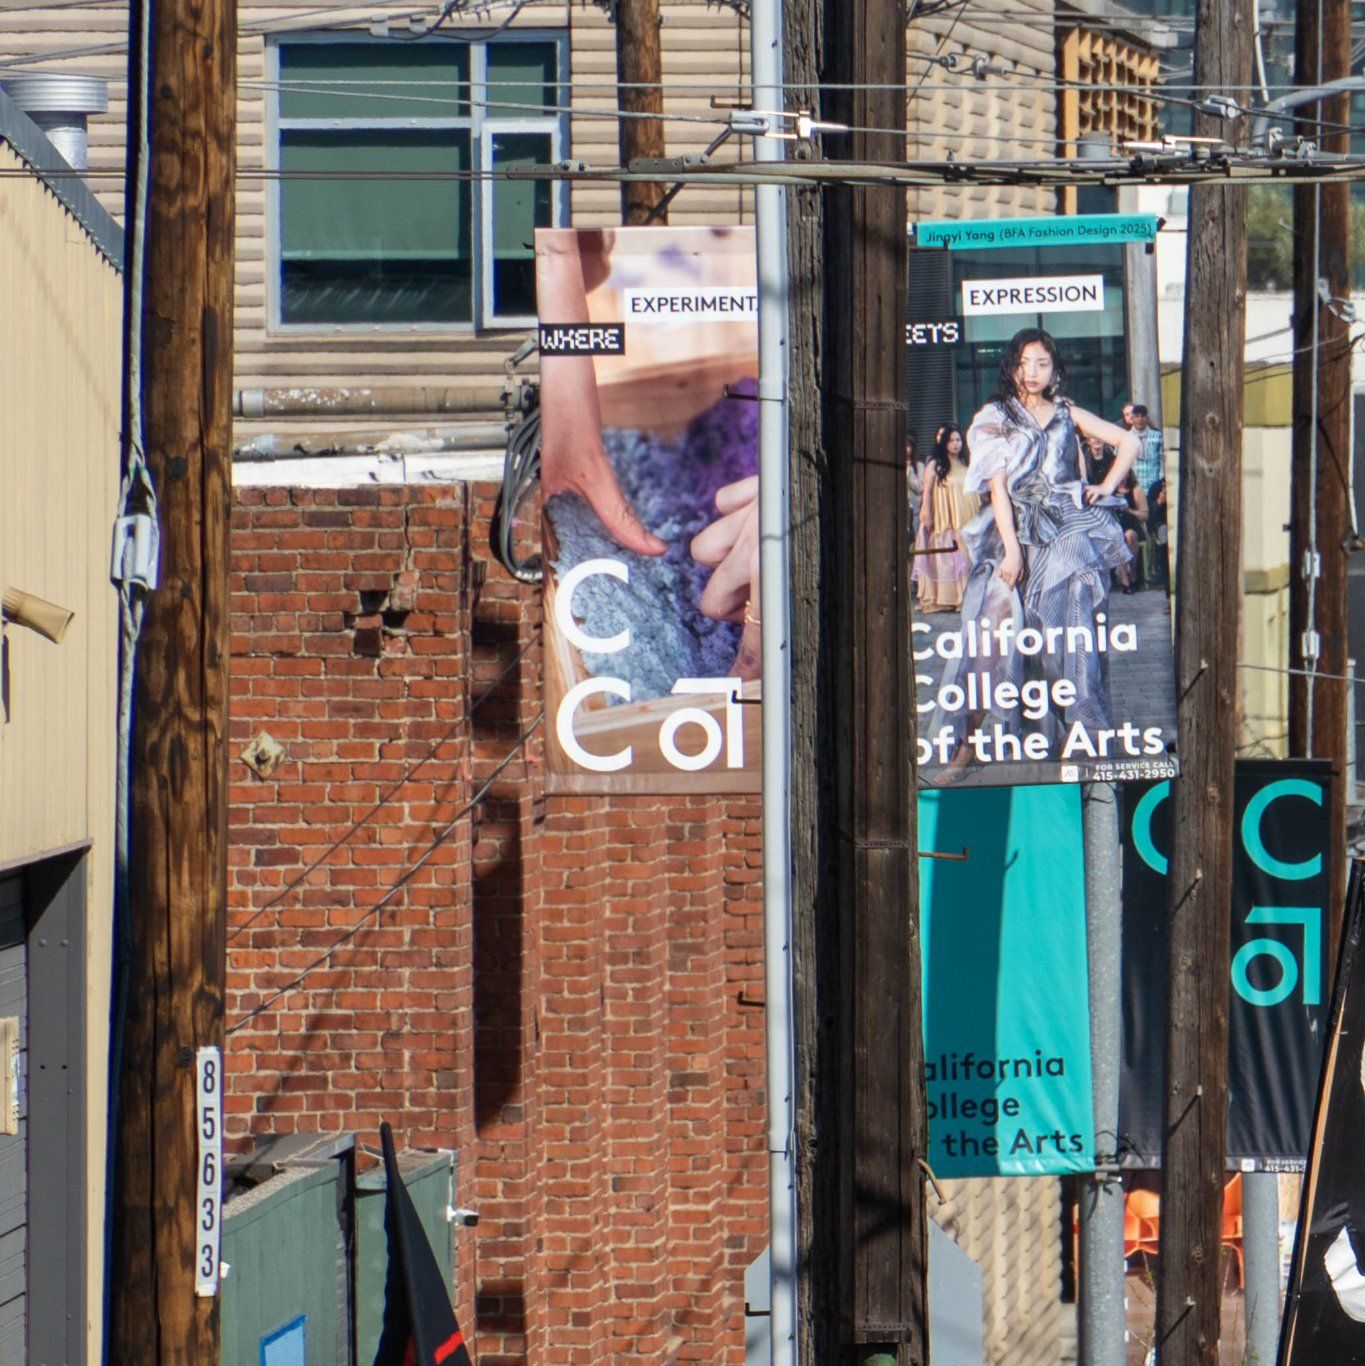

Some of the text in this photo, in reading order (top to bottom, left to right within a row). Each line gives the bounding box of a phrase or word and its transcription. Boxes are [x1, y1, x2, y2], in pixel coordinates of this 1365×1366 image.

[965, 229, 995, 243] Yang
[999, 228, 1026, 242] (BFA
[1029, 225, 1075, 238] Fashion
[1077, 223, 1116, 238] Design
[1120, 222, 1154, 237] 2025)
[631, 295, 758, 313] EXPERIMENT
[970, 285, 1097, 306] EXPRESSION
[555, 558, 631, 654] C
[911, 612, 1138, 661] California
[914, 671, 1077, 720] College
[968, 723, 1050, 762] the
[1061, 720, 1165, 759] Arts
[1092, 768, 1175, 782] 415-431-2950
[1114, 762, 1151, 770] SERVICE
[1152, 761, 1175, 769] CALL
[1241, 778, 1322, 880] C
[925, 1050, 1064, 1082] alifornia
[927, 1092, 1020, 1126] ollege
[941, 1128, 1084, 1157] the Arts
